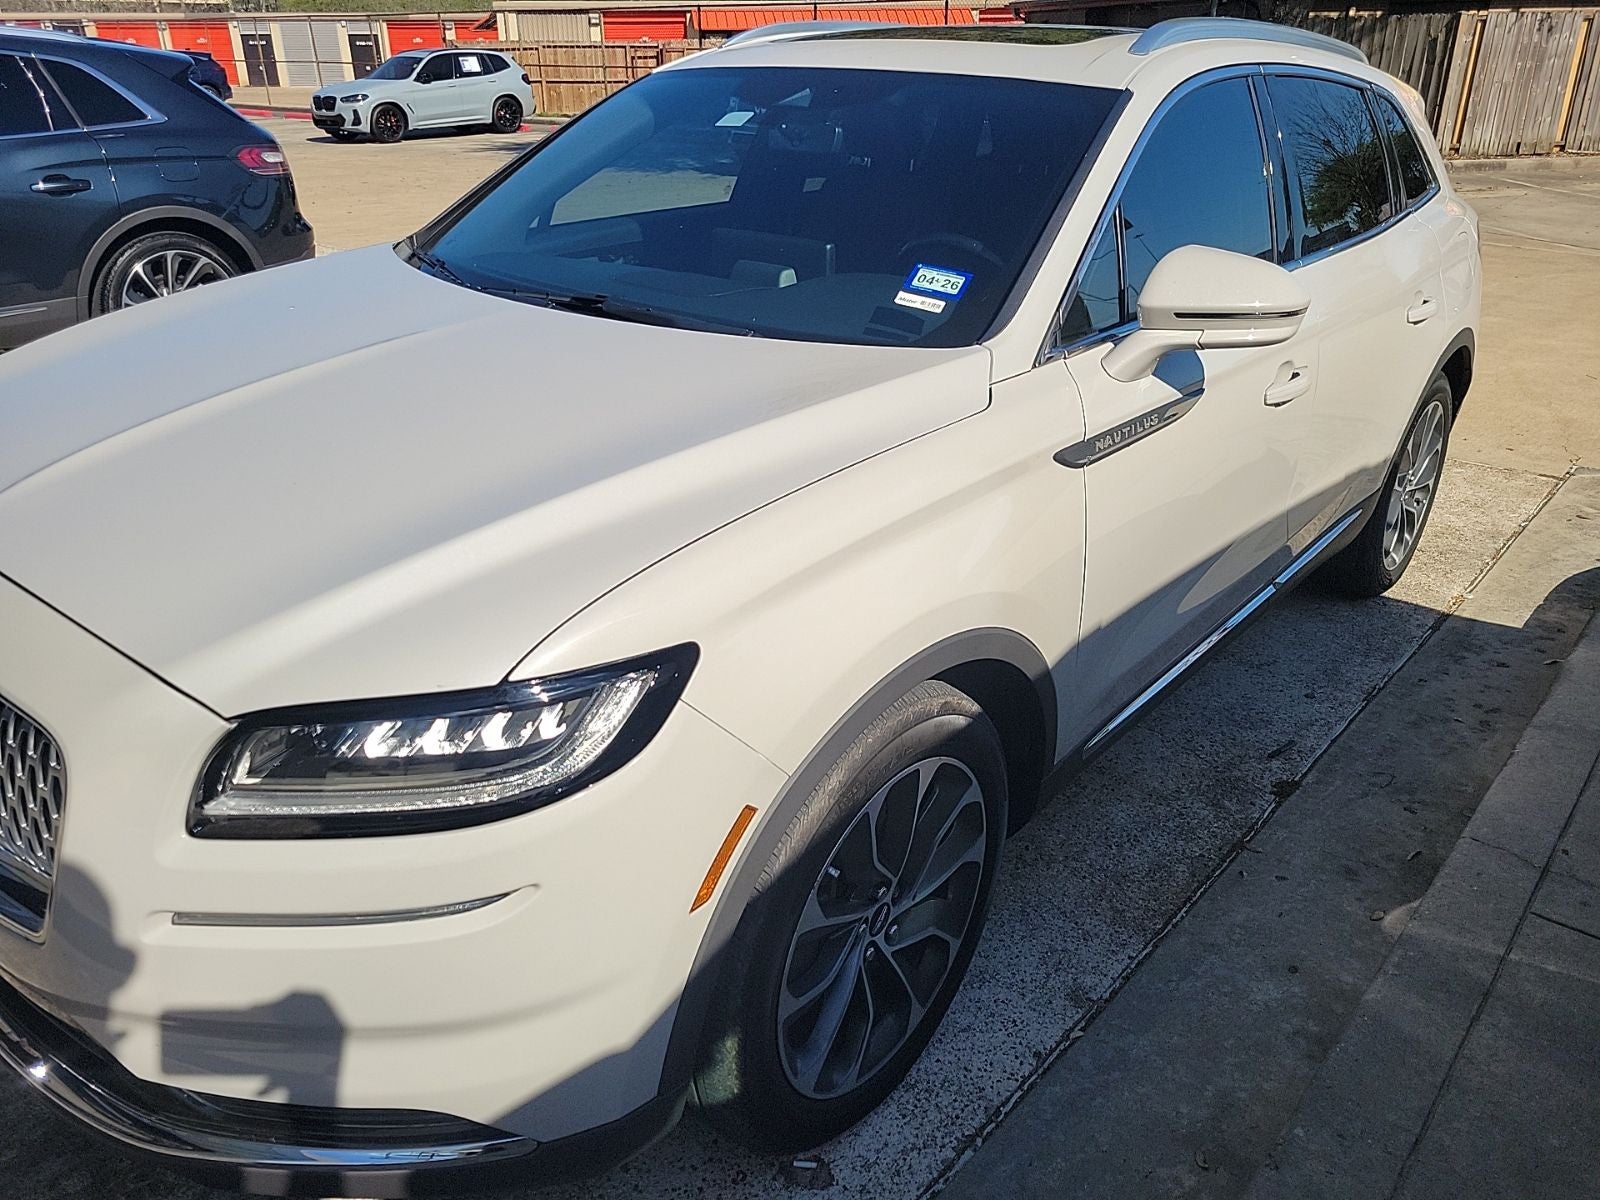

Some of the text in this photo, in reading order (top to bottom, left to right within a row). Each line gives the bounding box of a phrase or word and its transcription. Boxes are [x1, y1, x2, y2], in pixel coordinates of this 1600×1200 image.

[917, 274, 936, 285] 04
[940, 279, 961, 290] 26
[1094, 413, 1160, 453] NAUTILUS
